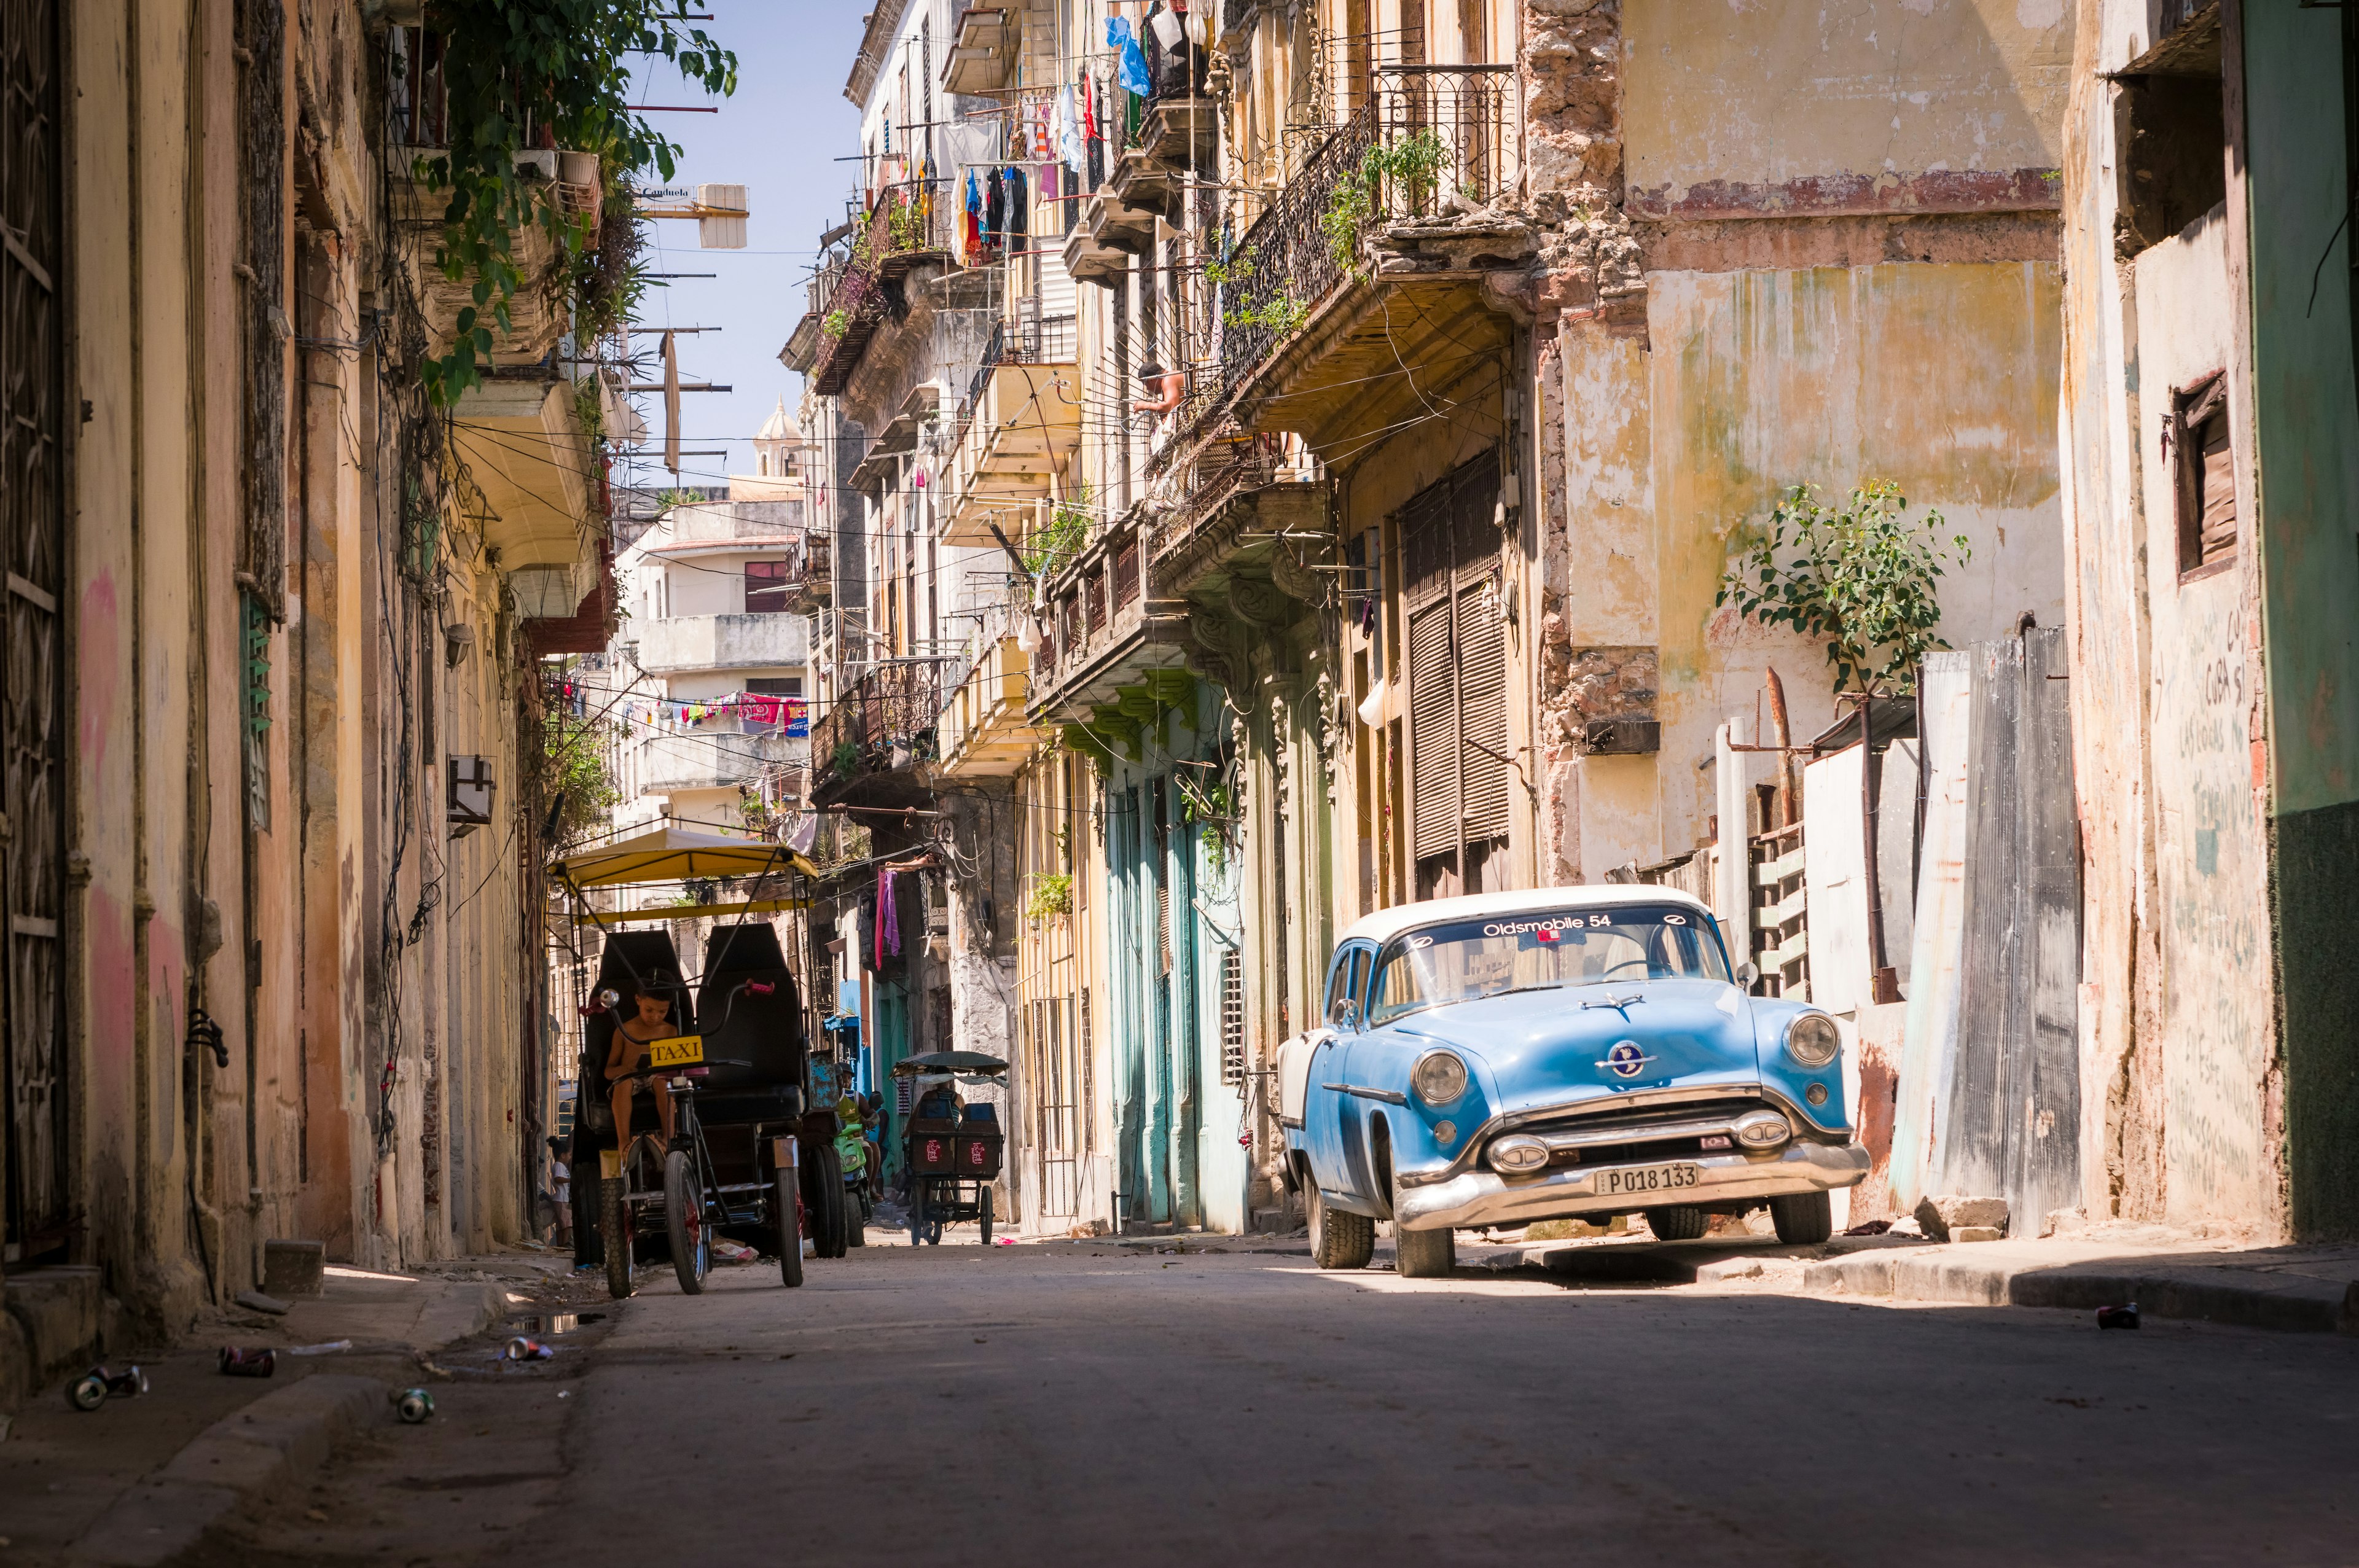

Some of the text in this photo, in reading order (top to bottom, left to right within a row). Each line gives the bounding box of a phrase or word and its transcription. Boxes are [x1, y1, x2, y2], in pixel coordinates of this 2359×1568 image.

[2205, 656, 2231, 704] CUBA
[1484, 917, 1584, 937] Oldsmobile
[1589, 915, 1611, 927] 54
[652, 1042, 698, 1061] TAXI
